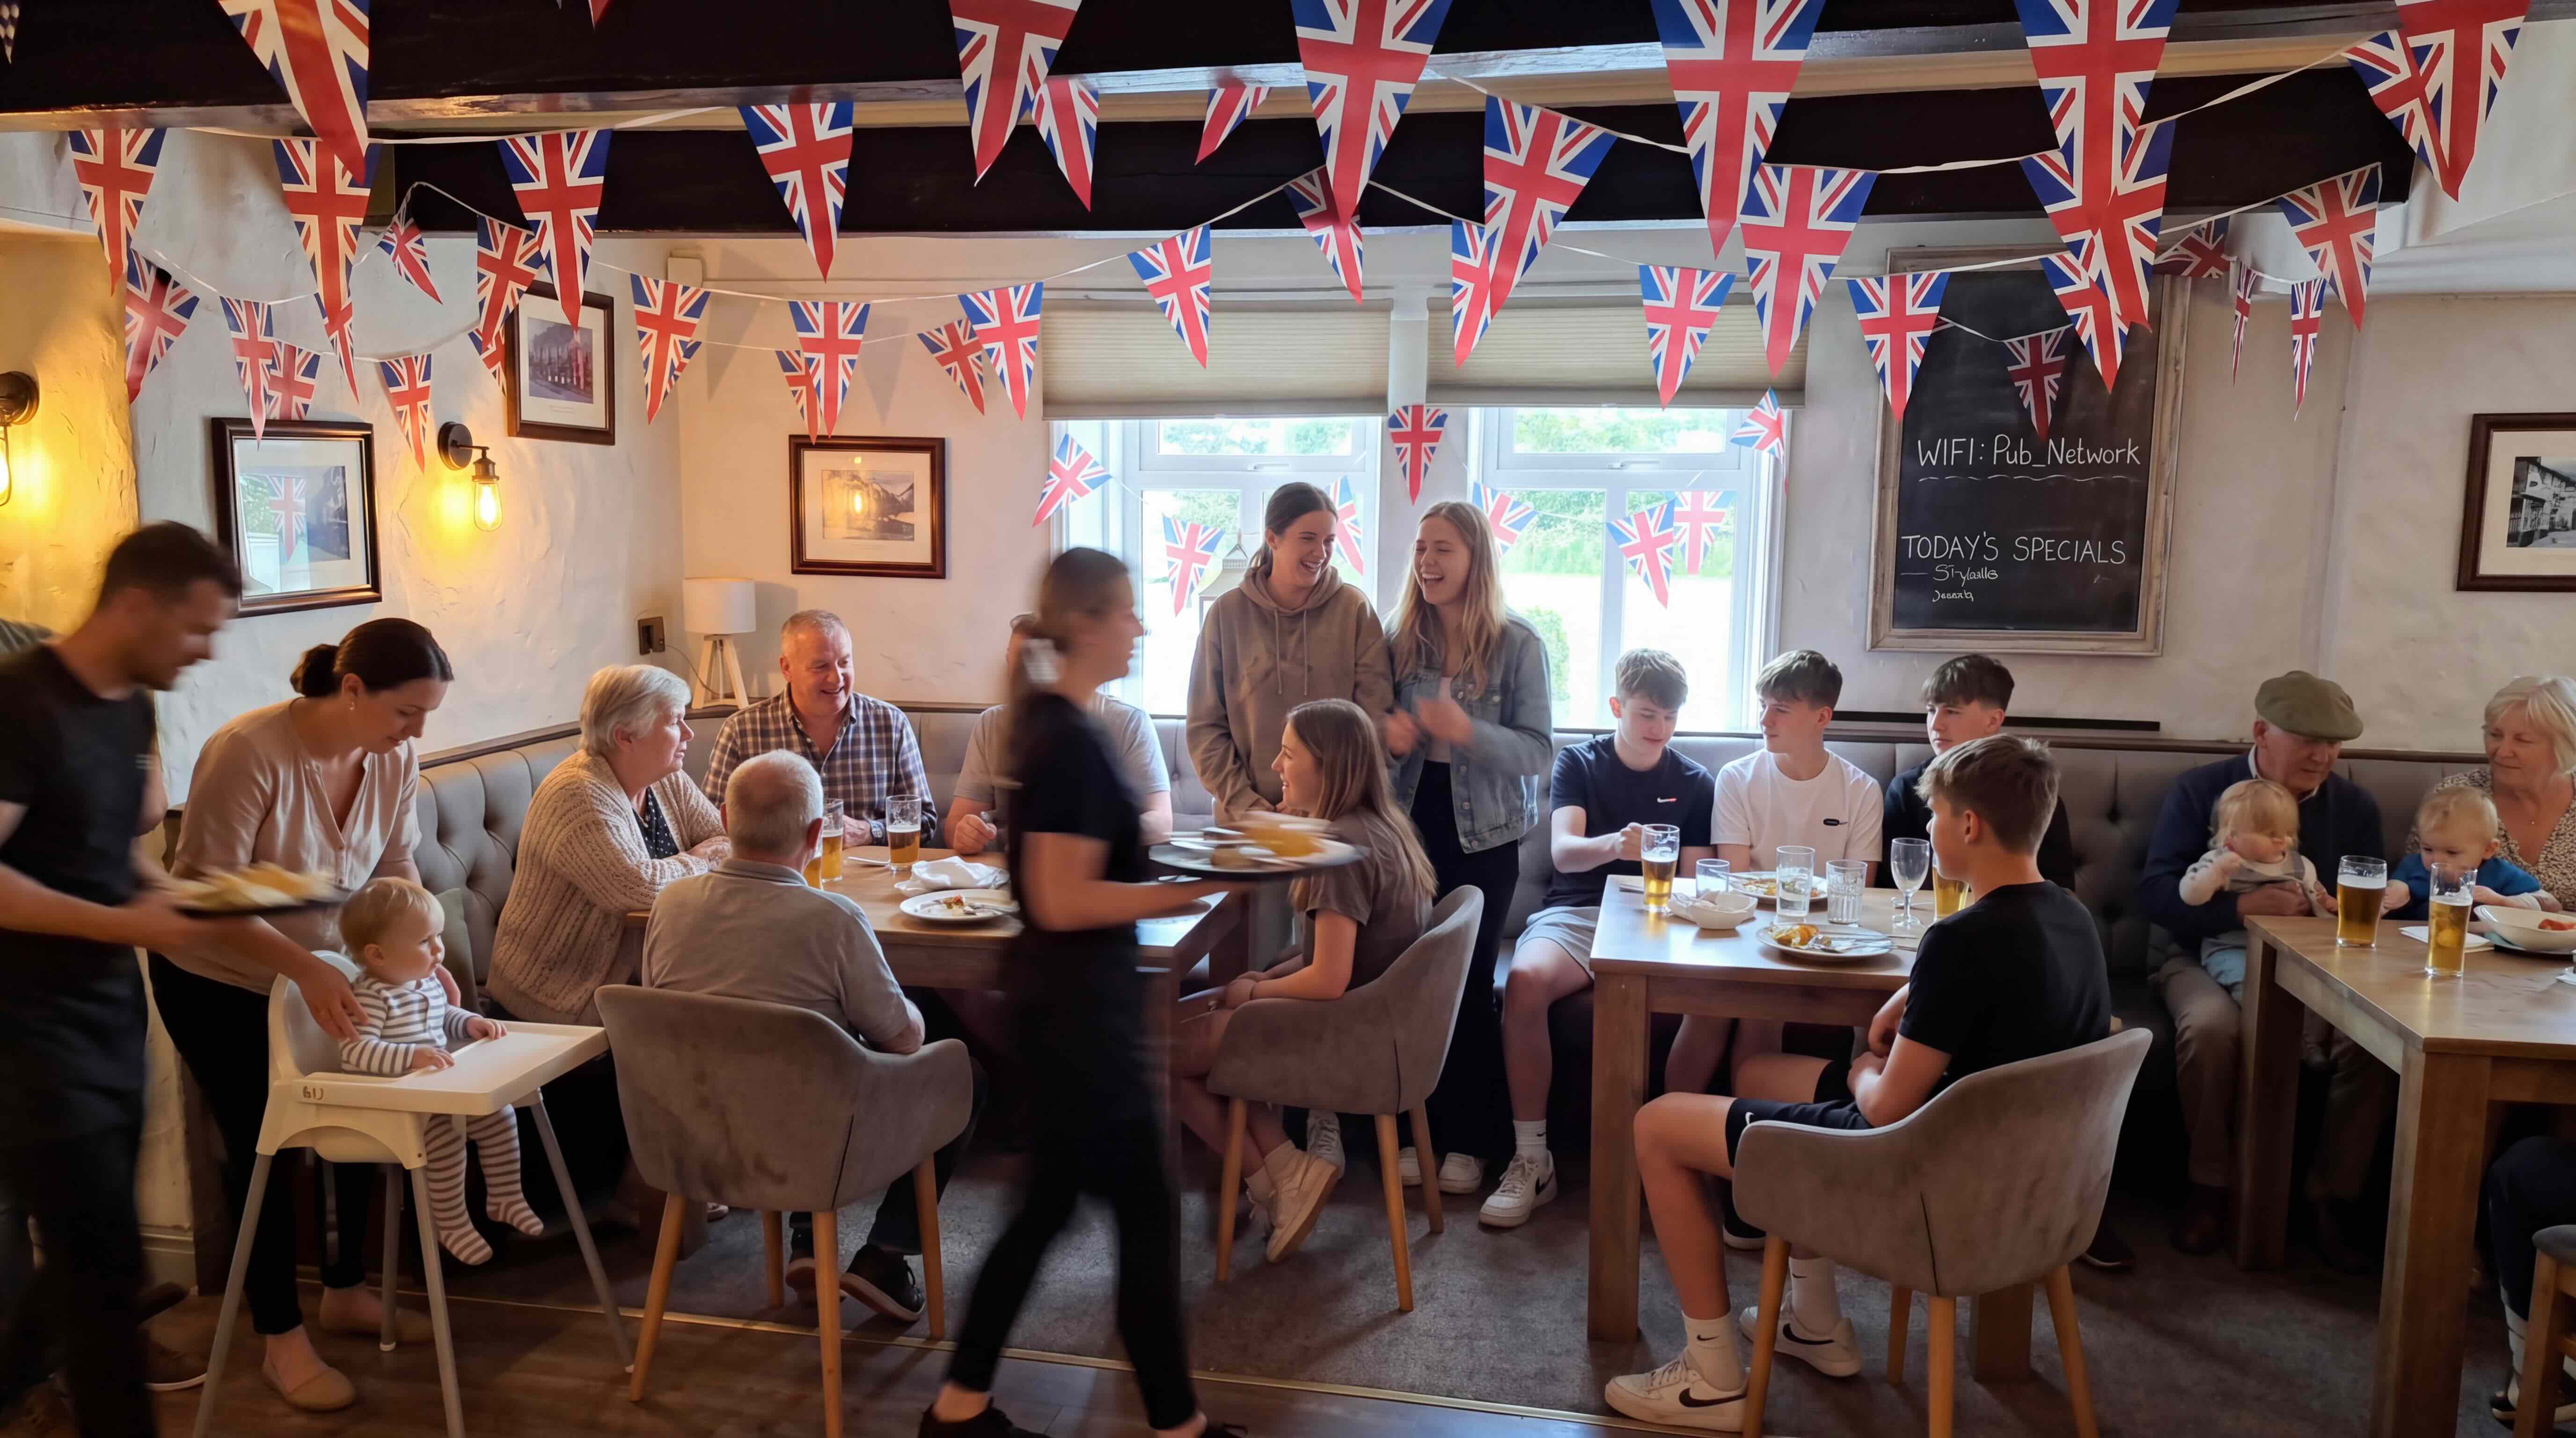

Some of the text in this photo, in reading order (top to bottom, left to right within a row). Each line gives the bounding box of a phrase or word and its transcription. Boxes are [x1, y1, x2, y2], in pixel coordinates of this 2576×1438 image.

[1918, 434, 2141, 467] WIFI: Pub_Network
[1902, 532, 2126, 565] TODAY'S SPECIALS
